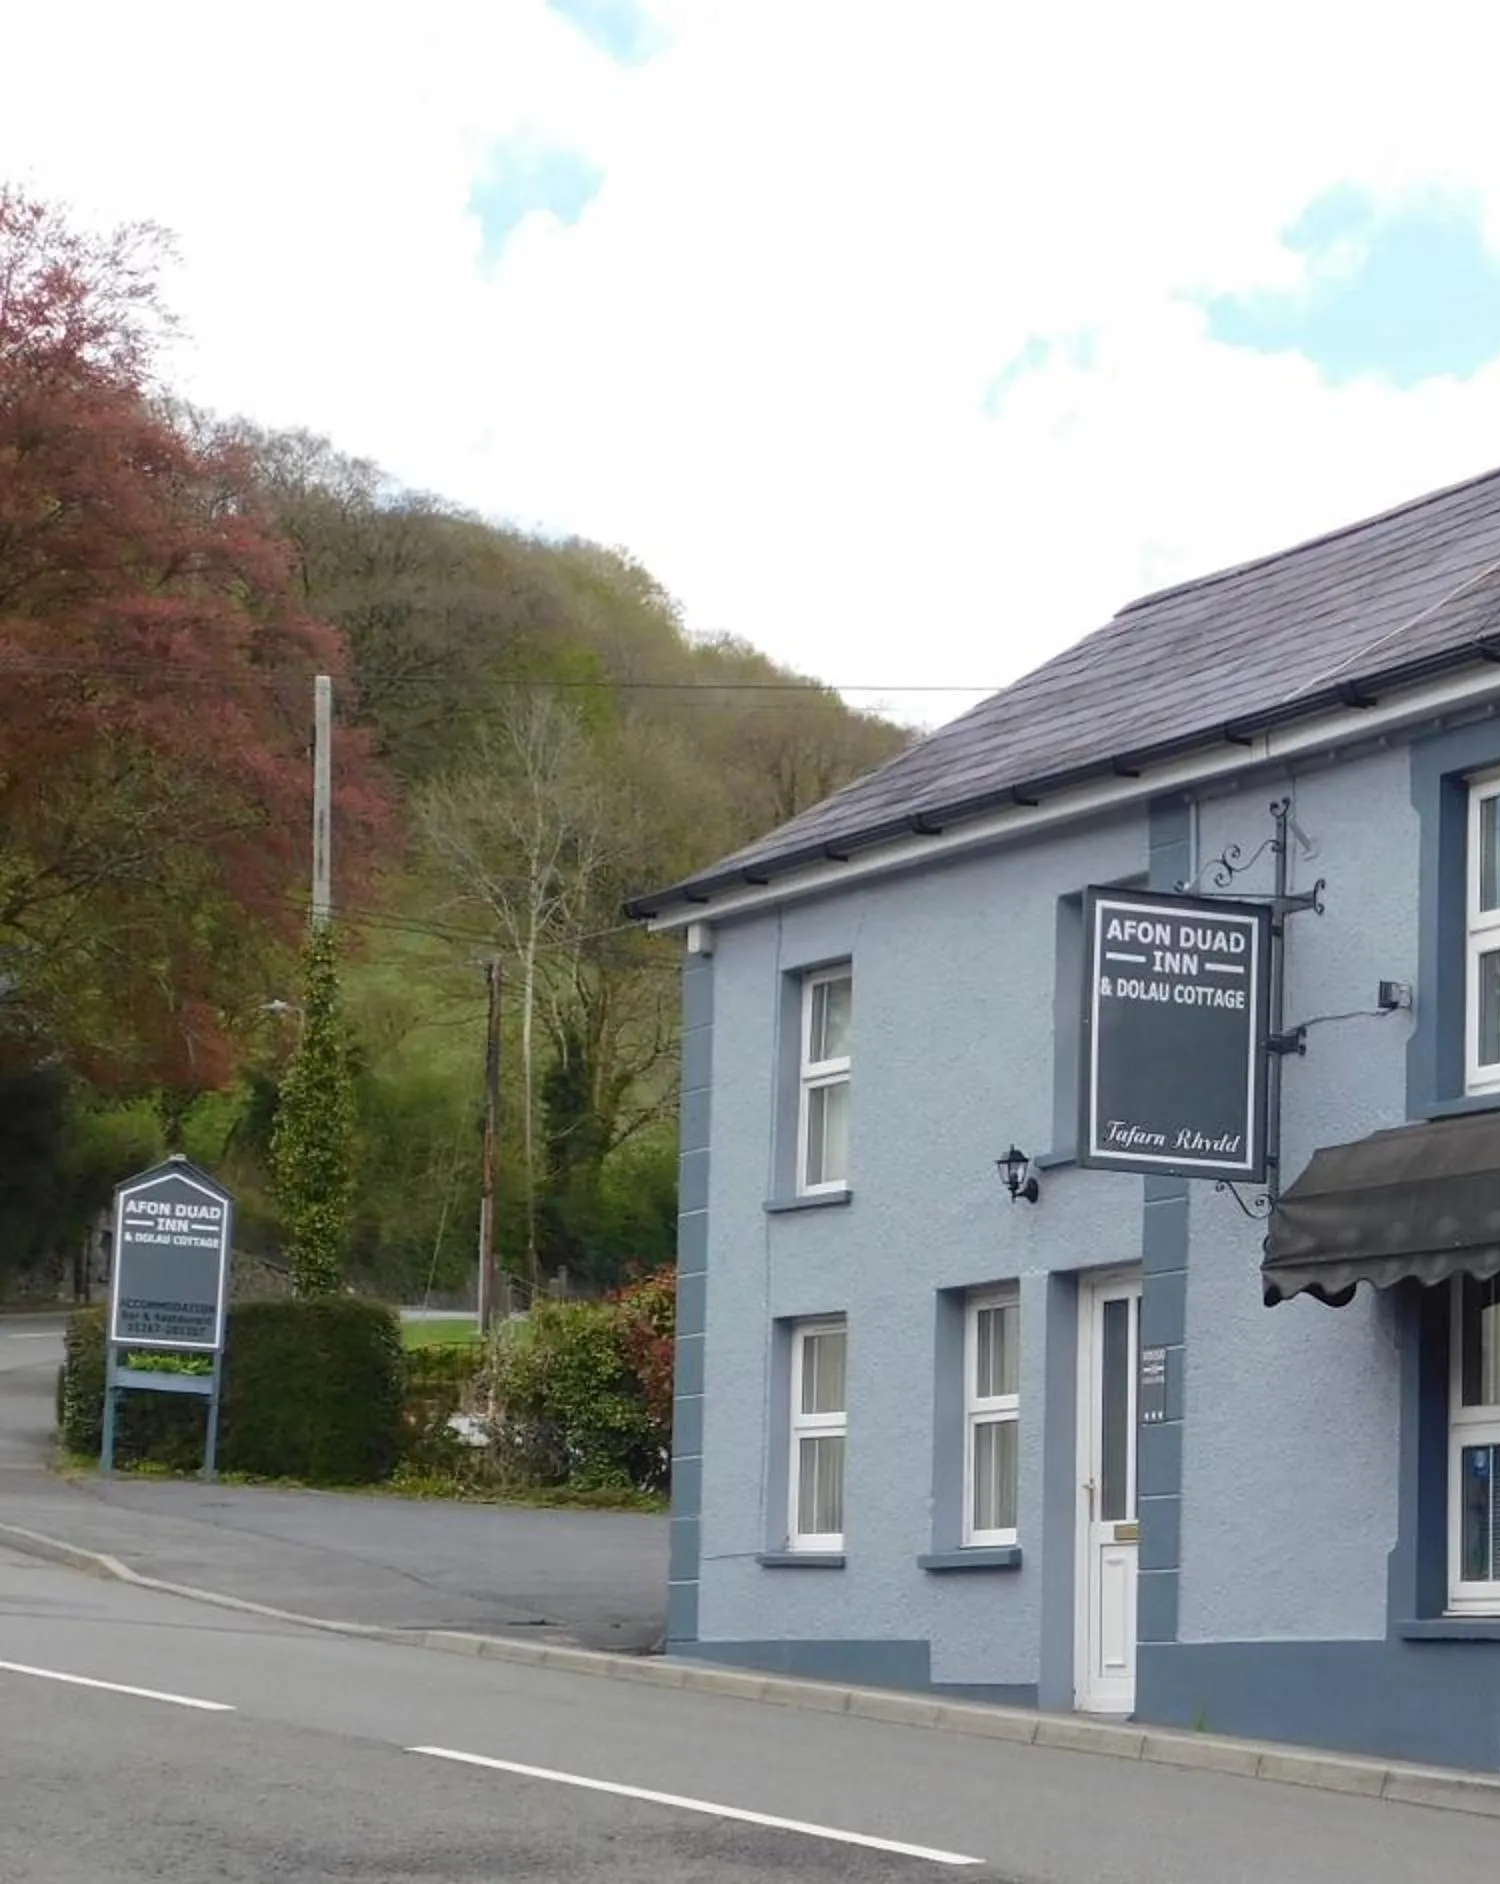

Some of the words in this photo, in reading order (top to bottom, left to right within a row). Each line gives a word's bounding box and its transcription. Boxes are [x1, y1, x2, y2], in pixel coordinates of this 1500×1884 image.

[1106, 918, 1172, 946] AFON
[1179, 926, 1246, 953] DUAD
[1152, 950, 1199, 976] INN
[1101, 975, 1113, 997] &
[1116, 977, 1170, 1001] DOLAU
[1173, 984, 1246, 1010] COTTAGE
[1104, 1119, 1167, 1148] Tafarn
[1171, 1127, 1240, 1153] Rhydd
[126, 1200, 171, 1216] AFON
[175, 1203, 221, 1219] DUAD
[156, 1218, 190, 1233] INN
[173, 1235, 219, 1249] COTTAGE
